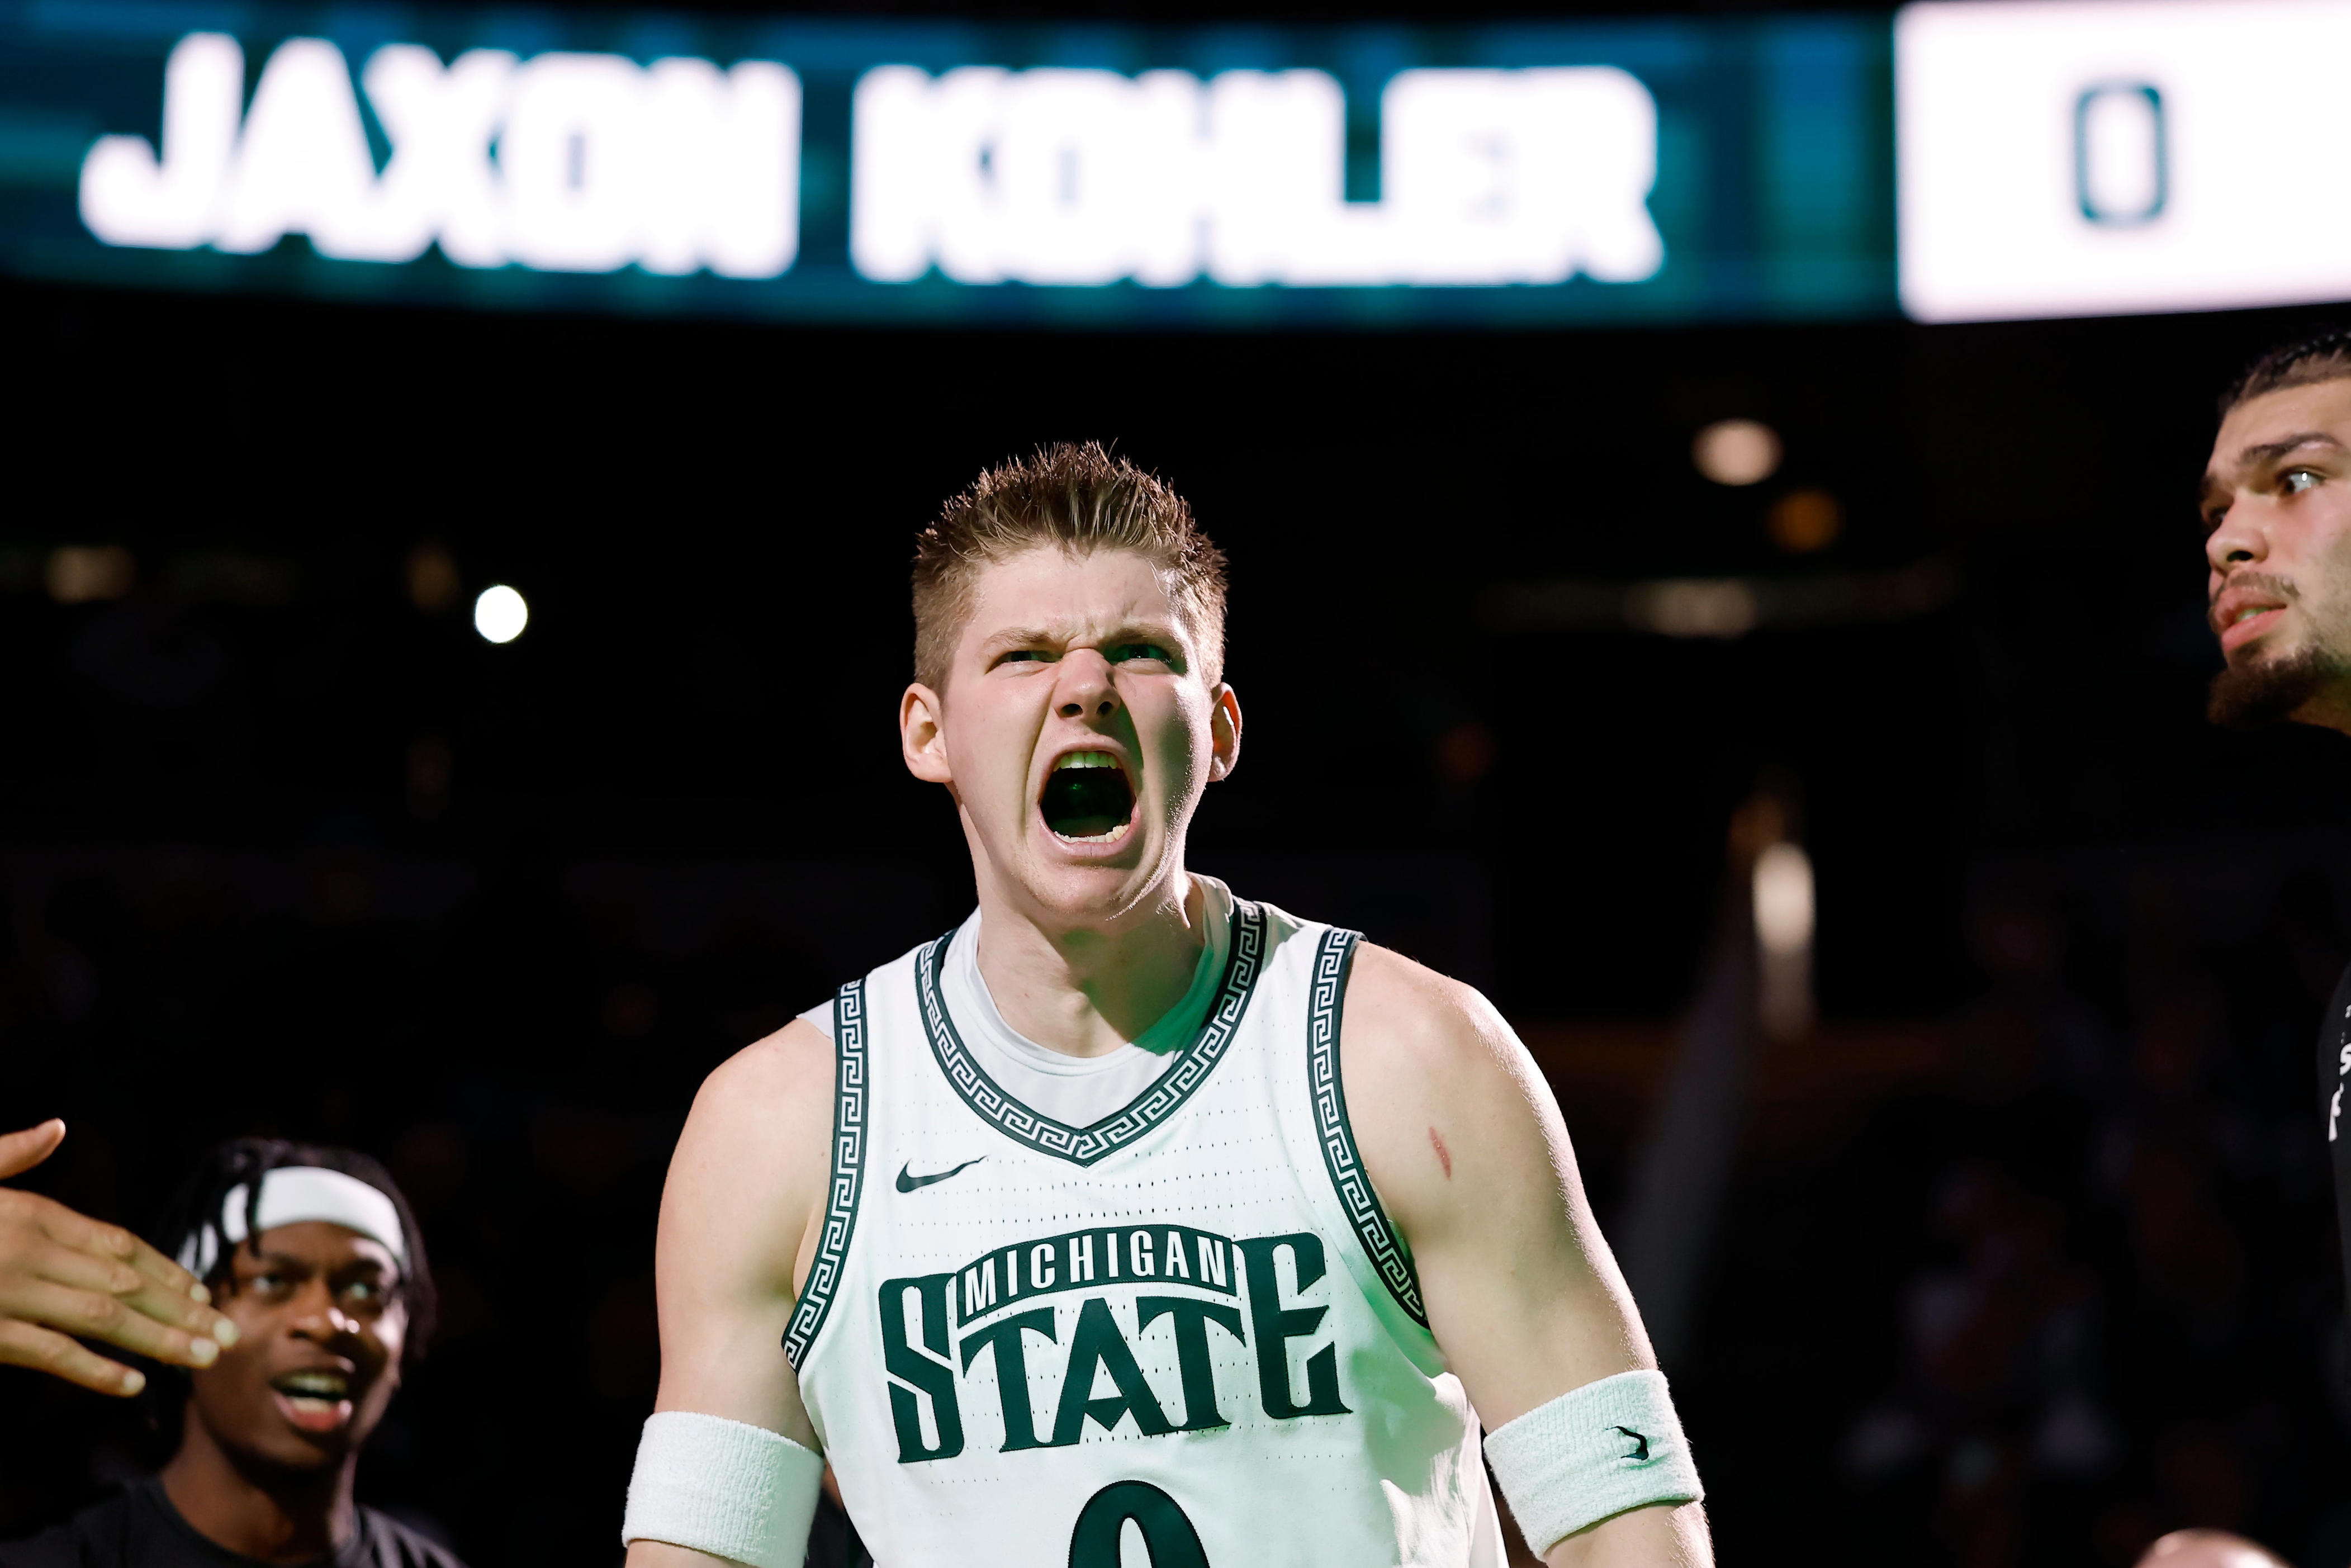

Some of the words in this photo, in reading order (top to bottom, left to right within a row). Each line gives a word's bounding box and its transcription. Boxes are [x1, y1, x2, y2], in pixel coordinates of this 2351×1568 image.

[79, 31, 802, 281] JAXON
[850, 64, 1665, 287] KOHLER
[2072, 78, 2170, 228] 0
[879, 1232, 1353, 1463] STATE
[964, 1229, 1229, 1317] MICHIGAN
